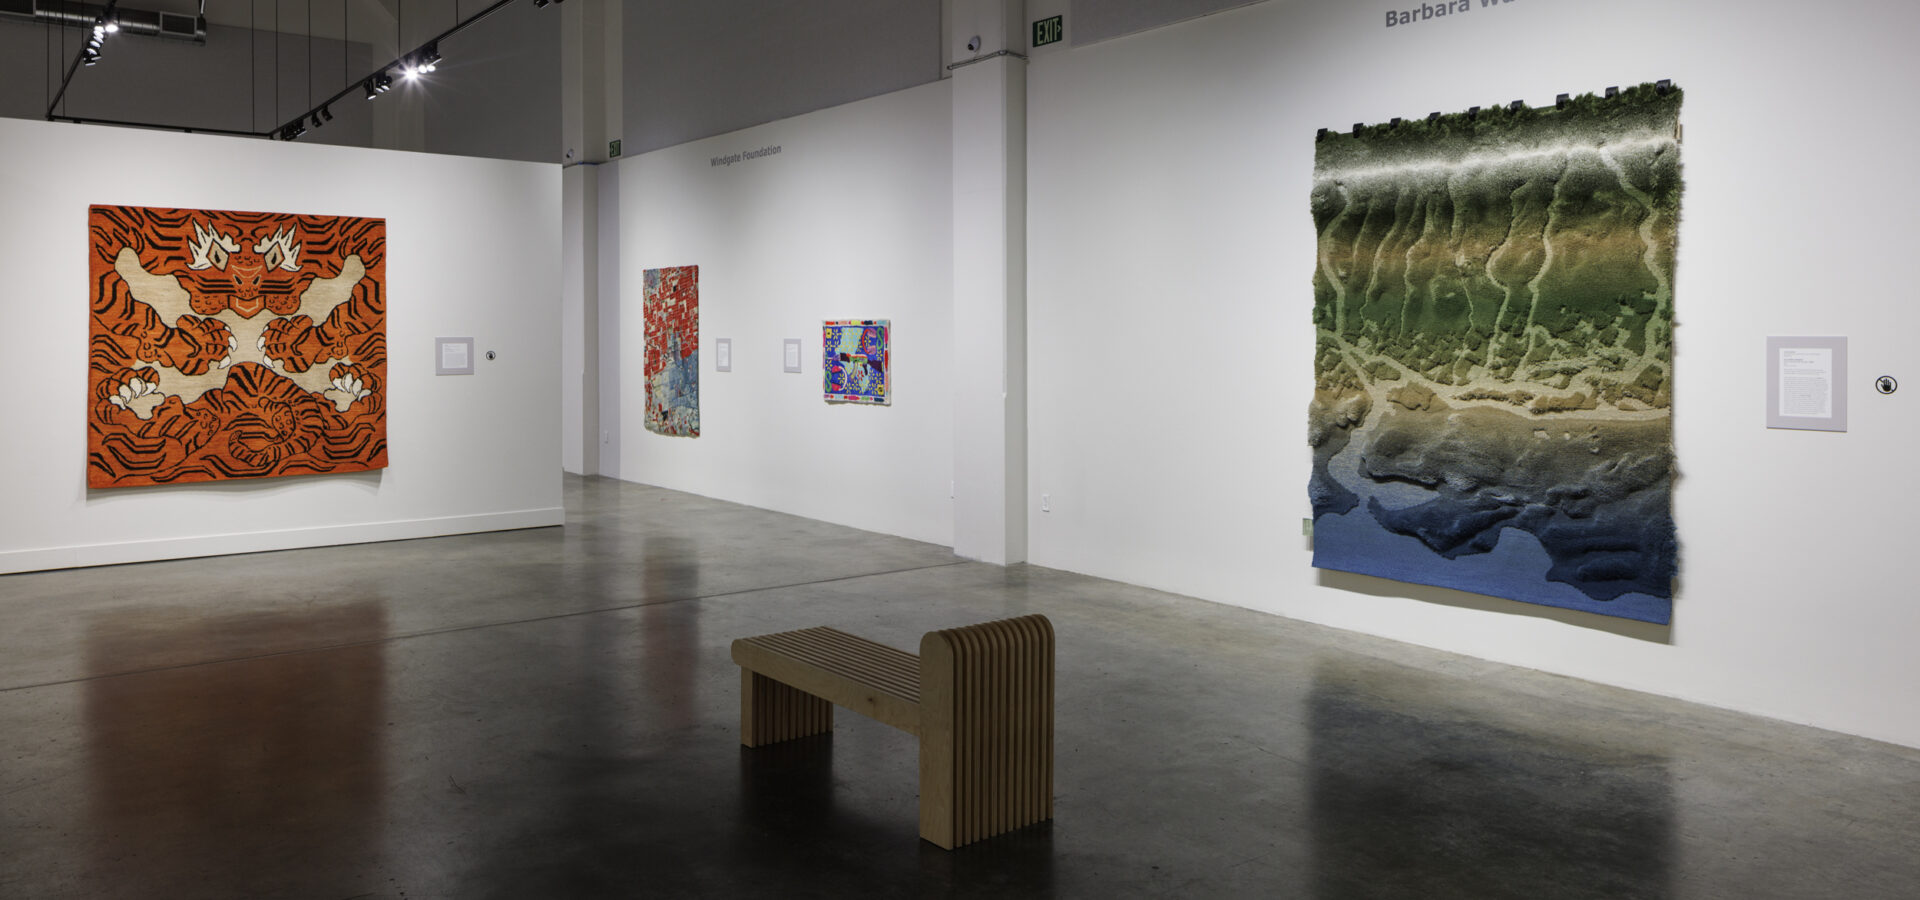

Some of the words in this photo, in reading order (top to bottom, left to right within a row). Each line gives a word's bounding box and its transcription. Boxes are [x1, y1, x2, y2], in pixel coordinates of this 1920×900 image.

[1385, 0, 1470, 27] Barbara
[1037, 17, 1059, 44] EXIT
[610, 141, 620, 156] EXIT
[710, 153, 741, 167] Windgate
[742, 145, 782, 161] Foundation
